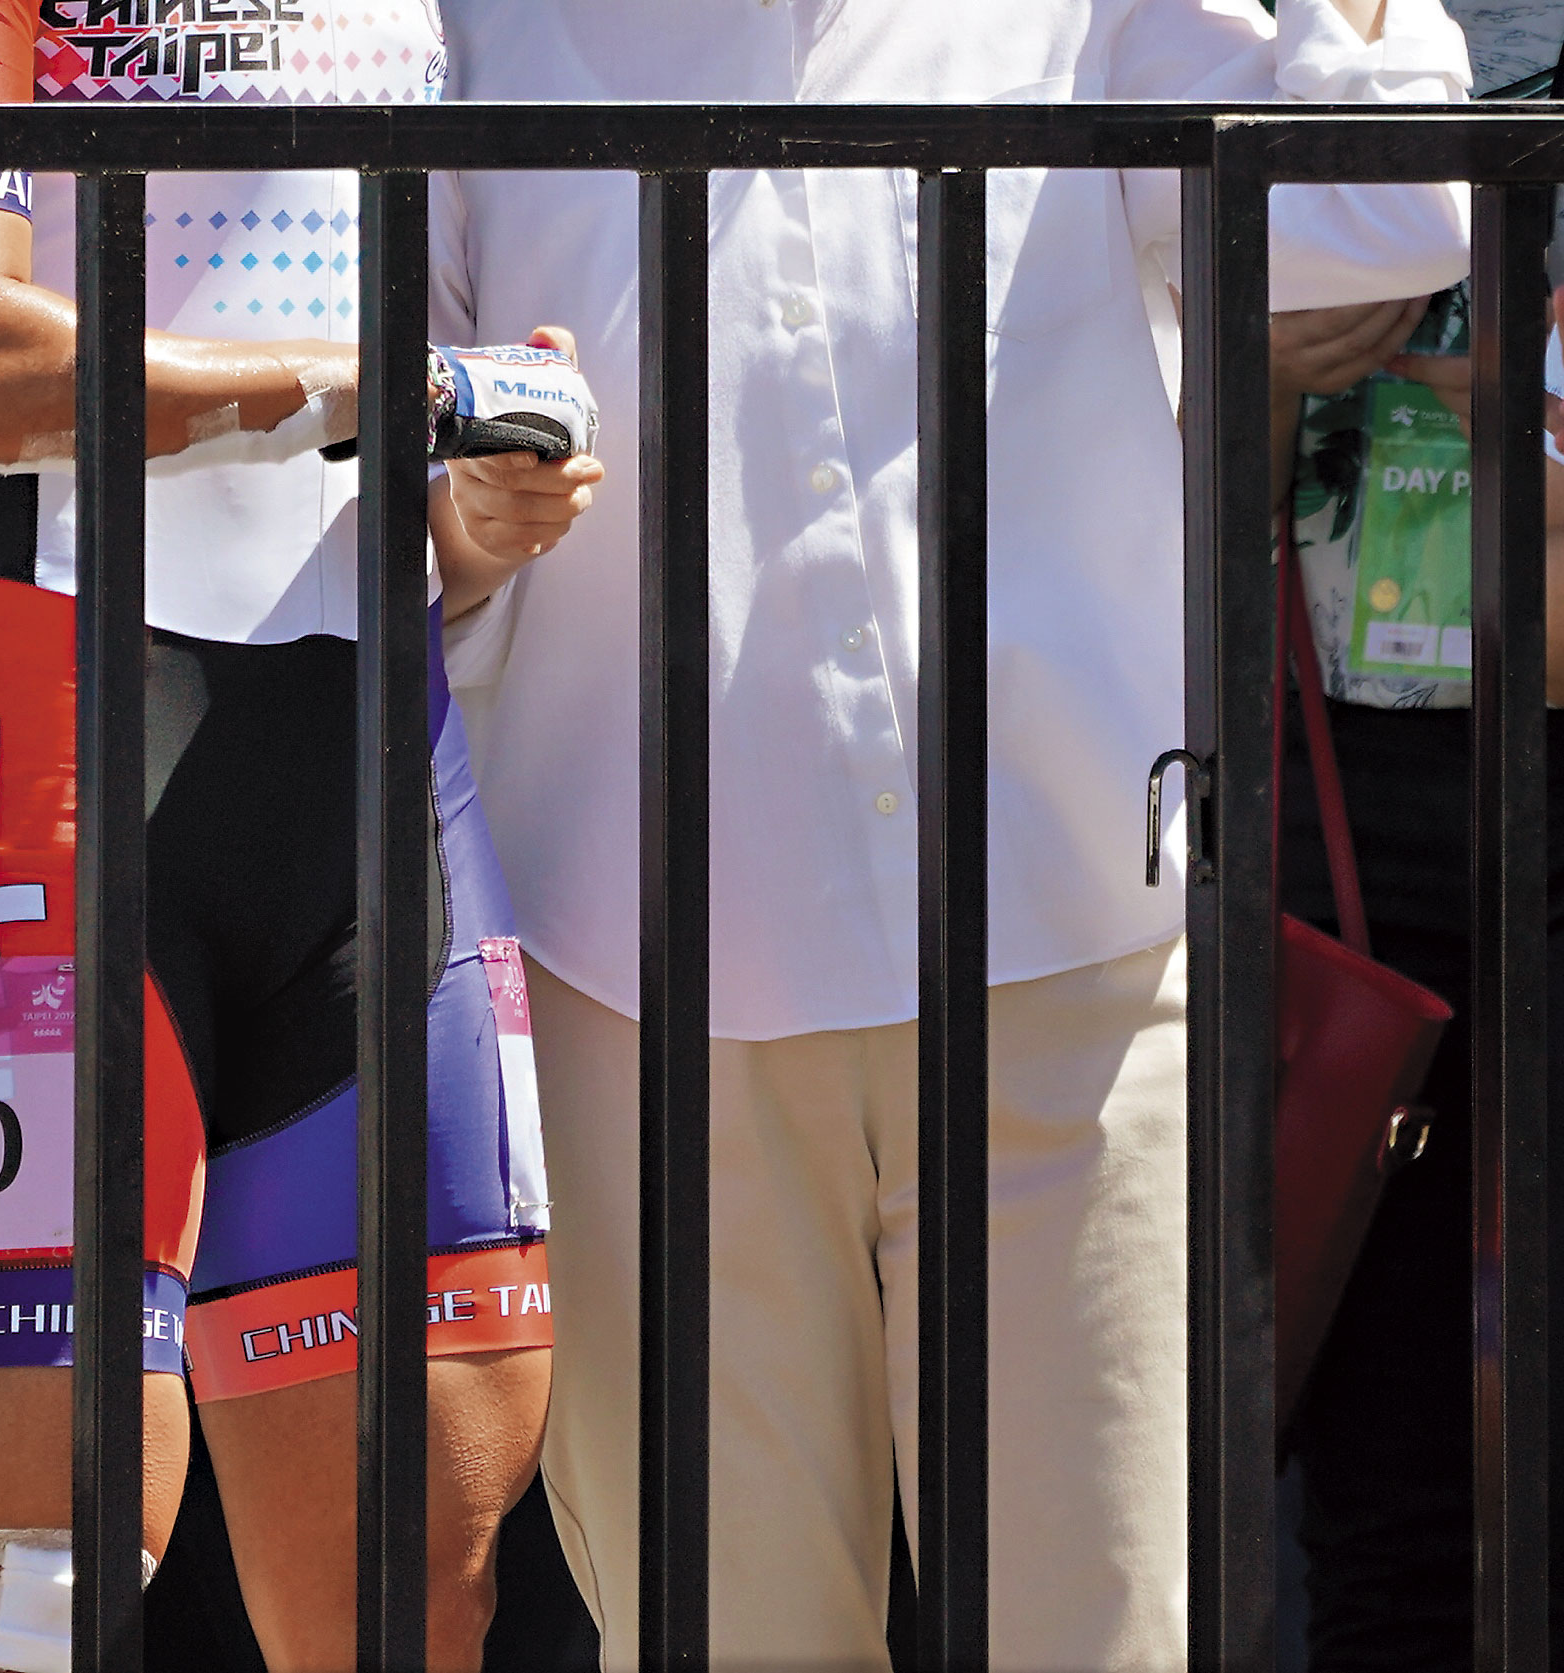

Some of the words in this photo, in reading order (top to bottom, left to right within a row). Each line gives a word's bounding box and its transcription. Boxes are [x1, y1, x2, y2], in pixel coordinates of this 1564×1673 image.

[1383, 466, 1446, 495] DAY
[22, 1012, 51, 1022] TAIPEI
[54, 1011, 75, 1021] 2017
